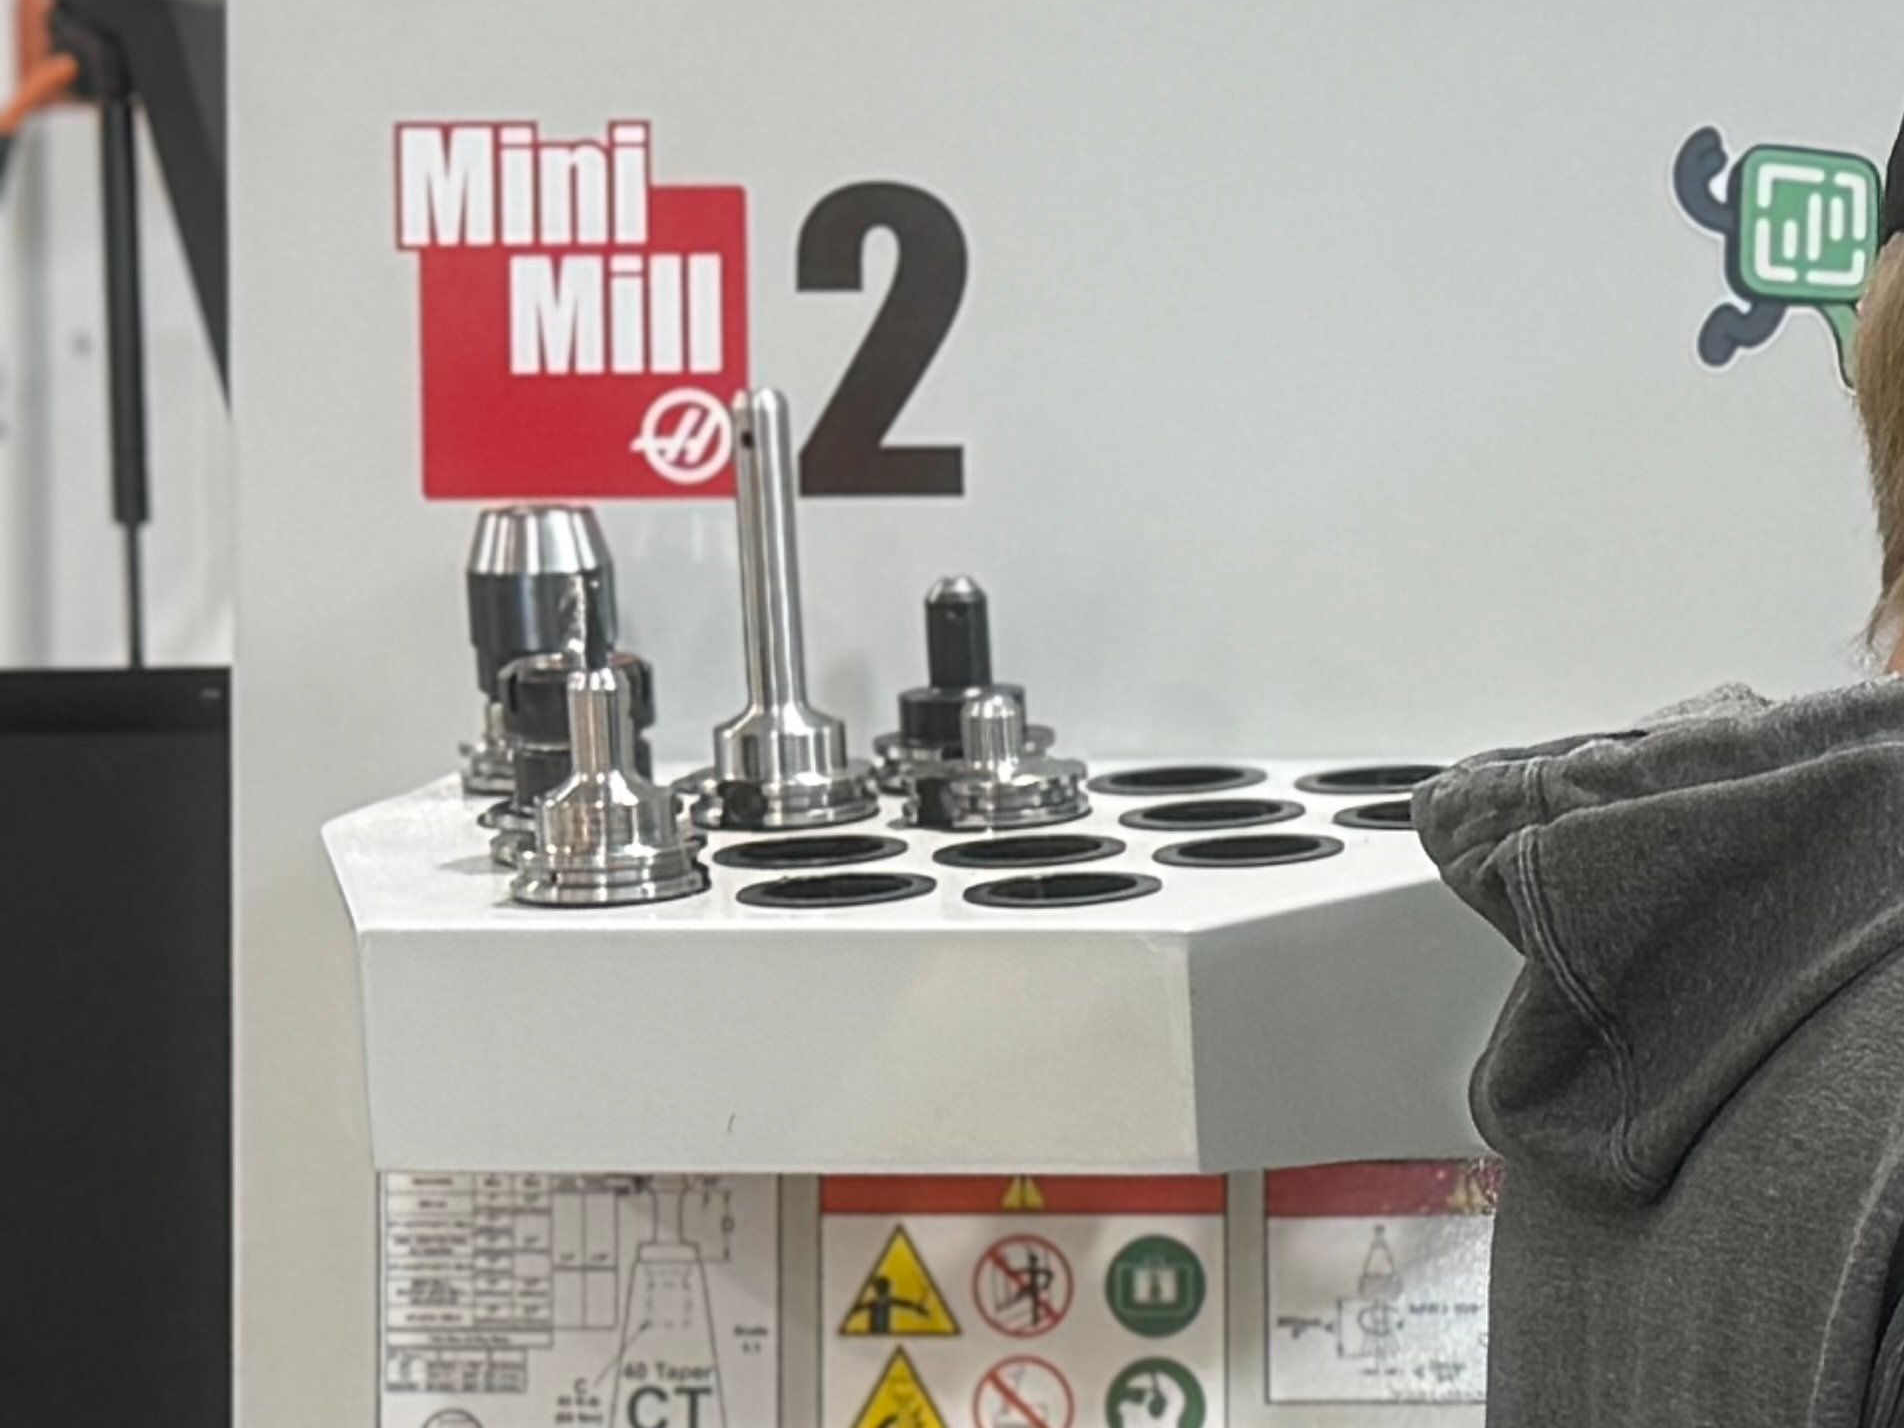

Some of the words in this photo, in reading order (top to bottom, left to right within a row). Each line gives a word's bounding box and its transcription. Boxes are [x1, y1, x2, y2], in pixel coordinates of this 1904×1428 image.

[398, 124, 648, 246] Mini
[510, 252, 722, 375] Mill
[795, 179, 968, 497] 2
[655, 1362, 712, 1380] Taper
